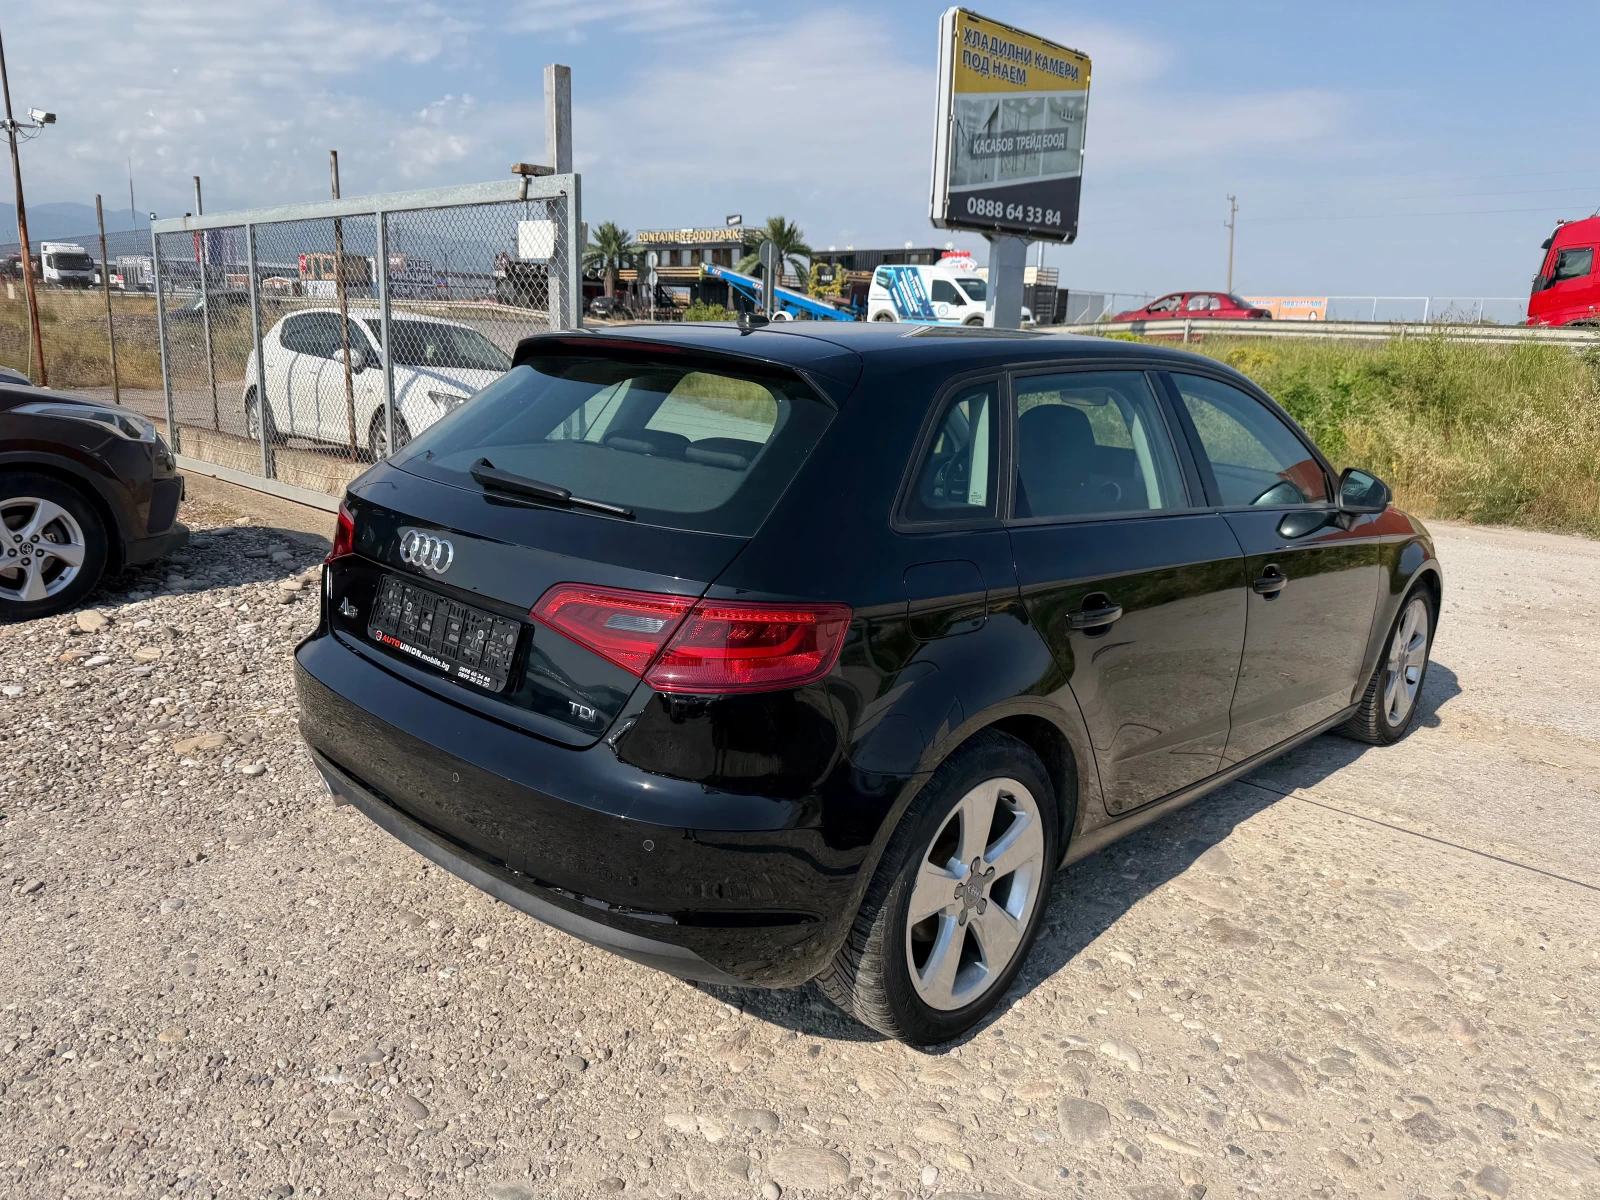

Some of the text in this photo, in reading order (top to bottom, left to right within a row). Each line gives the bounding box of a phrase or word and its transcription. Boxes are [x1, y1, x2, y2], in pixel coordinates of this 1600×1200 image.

[963, 26, 1079, 81] ХЛАДИЛНИ КАМЕРИ
[962, 50, 1027, 85] ПОД НАЕМ
[973, 132, 1065, 154] КАСАБОВ ТРЕЙД ЕООД
[966, 197, 1061, 226] 0888 64 33 84
[637, 228, 740, 243] CONTAINER FOOD PARK
[568, 701, 598, 723] TDI
